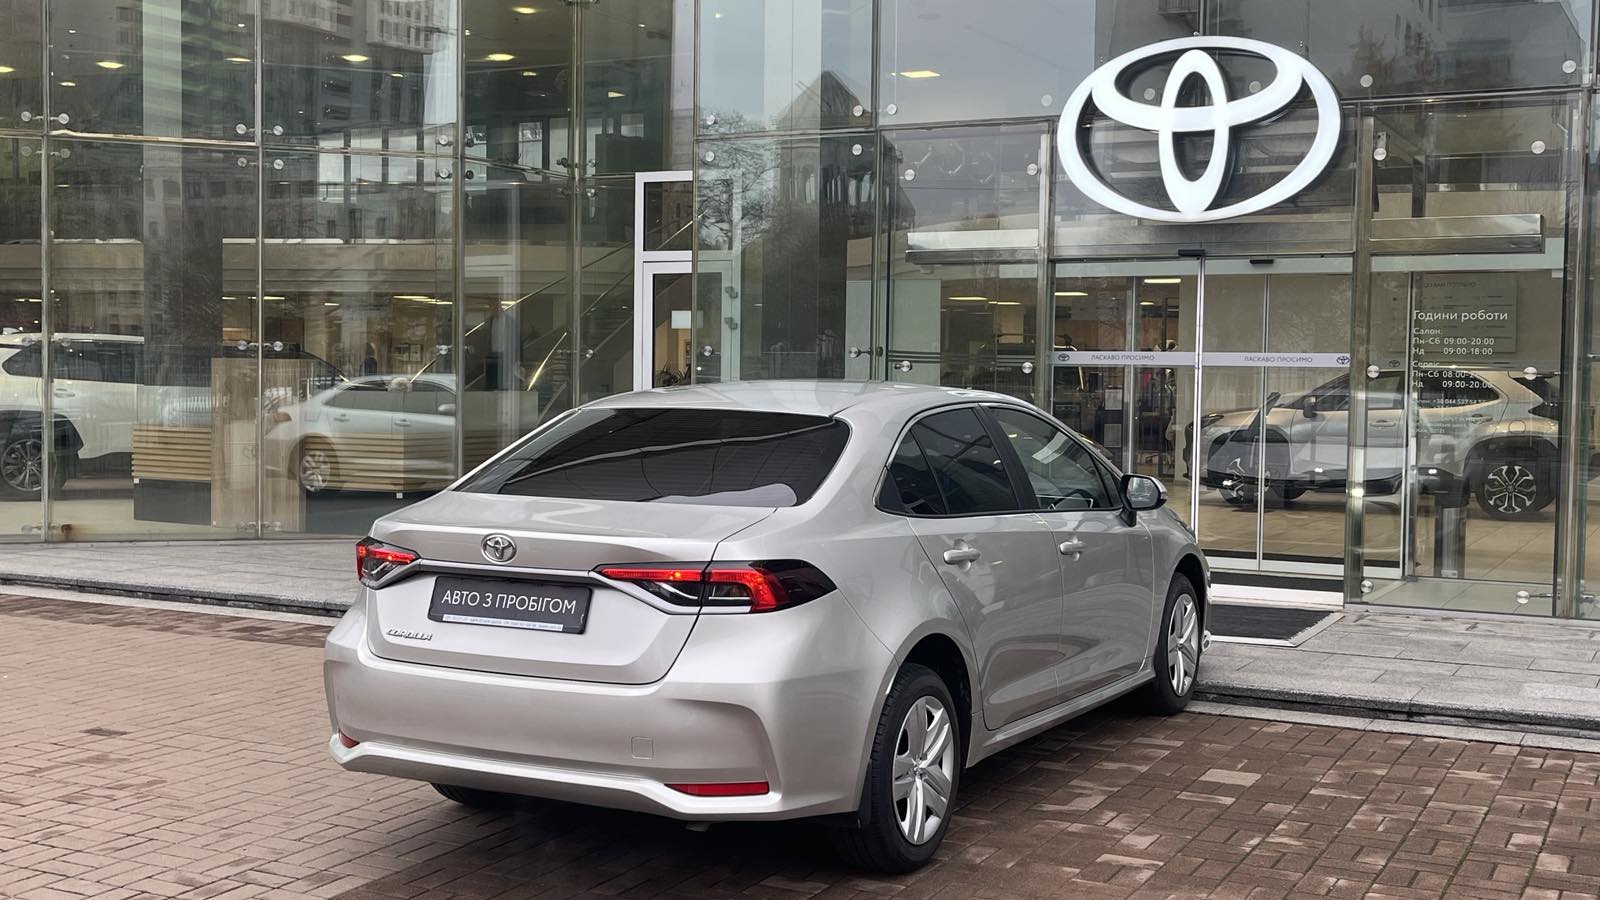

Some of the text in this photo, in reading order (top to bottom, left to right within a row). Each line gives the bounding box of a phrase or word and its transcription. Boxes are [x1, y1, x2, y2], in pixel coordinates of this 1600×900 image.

[1413, 309, 1508, 322] Години роботи
[1412, 337, 1495, 345] Пн-Сб 09:00-20:00
[1412, 347, 1493, 355] Нд 09:00-18:00
[441, 589, 480, 606] АВТО
[495, 593, 577, 614] ПРОБІГОМ
[385, 628, 434, 641] COROLLA
